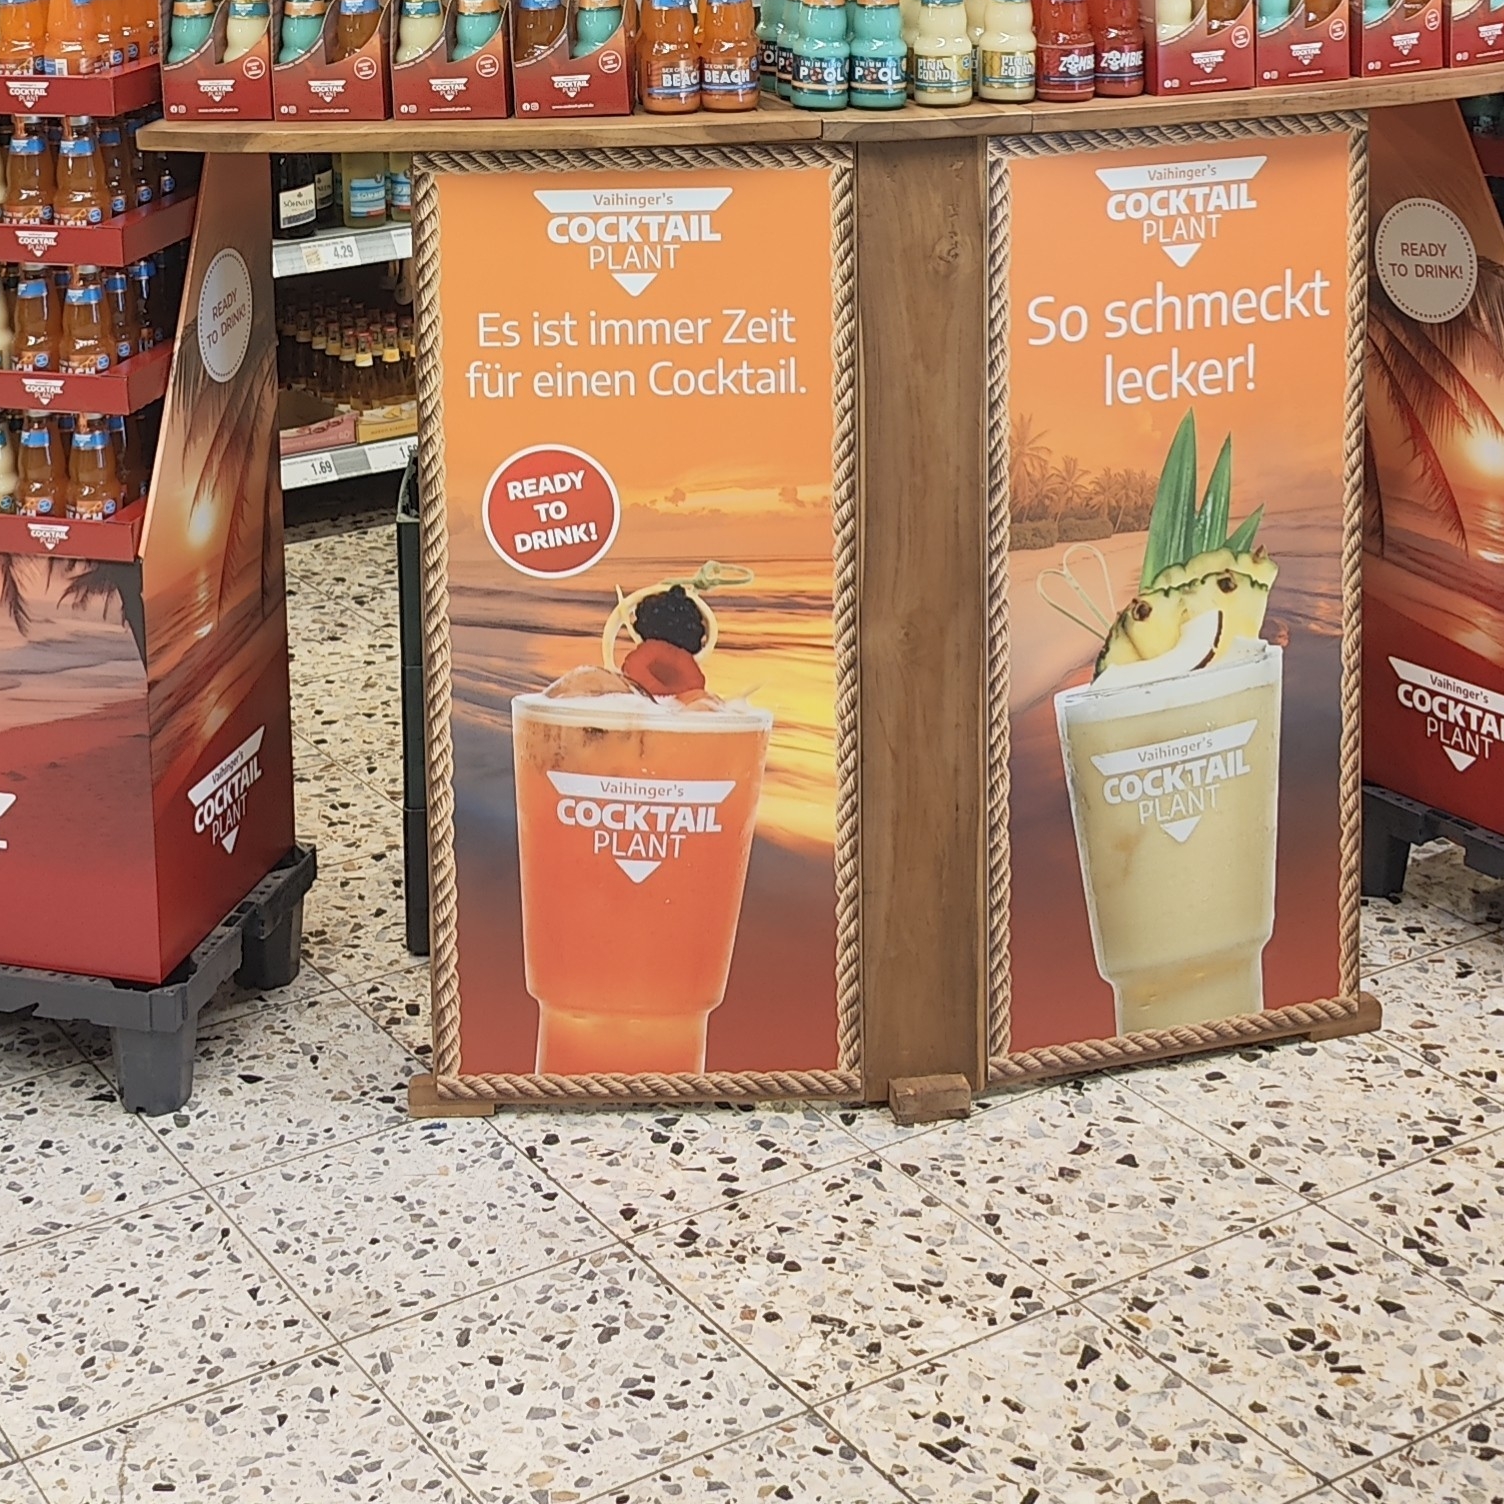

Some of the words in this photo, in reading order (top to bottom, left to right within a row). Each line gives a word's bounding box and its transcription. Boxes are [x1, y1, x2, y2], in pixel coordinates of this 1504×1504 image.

[704, 69, 750, 84] BEACH
[9, 87, 48, 97] COCKTAIL
[1147, 163, 1217, 183] Vaihinger's
[593, 192, 674, 209] Vaihinger's
[1106, 183, 1257, 221] COCKTAIL
[18, 236, 57, 246] COCKTAIL
[547, 214, 722, 244] COCKTAIL
[1142, 214, 1223, 245] PLANT
[333, 244, 354, 260] 4.29
[588, 244, 681, 270] PLANT
[1400, 241, 1448, 258] READY
[1389, 262, 1409, 278] TO
[1414, 262, 1464, 281] DRINK!
[212, 287, 238, 321] READY
[1027, 295, 1089, 346] So
[1104, 268, 1331, 340] schmeckt
[206, 333, 219, 349] TO
[221, 306, 247, 337] DRINK!
[477, 312, 521, 347] Es
[532, 311, 579, 347] ist
[590, 310, 712, 346] immer
[721, 307, 797, 344] Zeit
[25, 384, 64, 394] COCKTAIL
[465, 360, 522, 398] für
[532, 363, 636, 397] einen
[648, 357, 808, 396] Cocktail.
[1104, 343, 1258, 407] lecker!
[311, 460, 333, 476] 1.69
[506, 470, 586, 502] READY
[533, 501, 568, 523] TO
[30, 529, 69, 540] COCKTAIL
[514, 521, 599, 554] DRINK!
[1430, 674, 1490, 704] Vaihinger's
[1137, 736, 1214, 765] Vaihinger's
[1426, 716, 1494, 760] PLANT
[212, 750, 245, 785] Vaihinger's
[1102, 748, 1251, 805] COCKTAIL
[194, 755, 262, 834] COCKTAIL
[599, 780, 685, 798] Vaihinger's
[212, 792, 248, 846] PLANT
[556, 798, 723, 833] COCKTAIL
[1138, 783, 1222, 826] PLANT
[593, 830, 687, 859] PLANT
